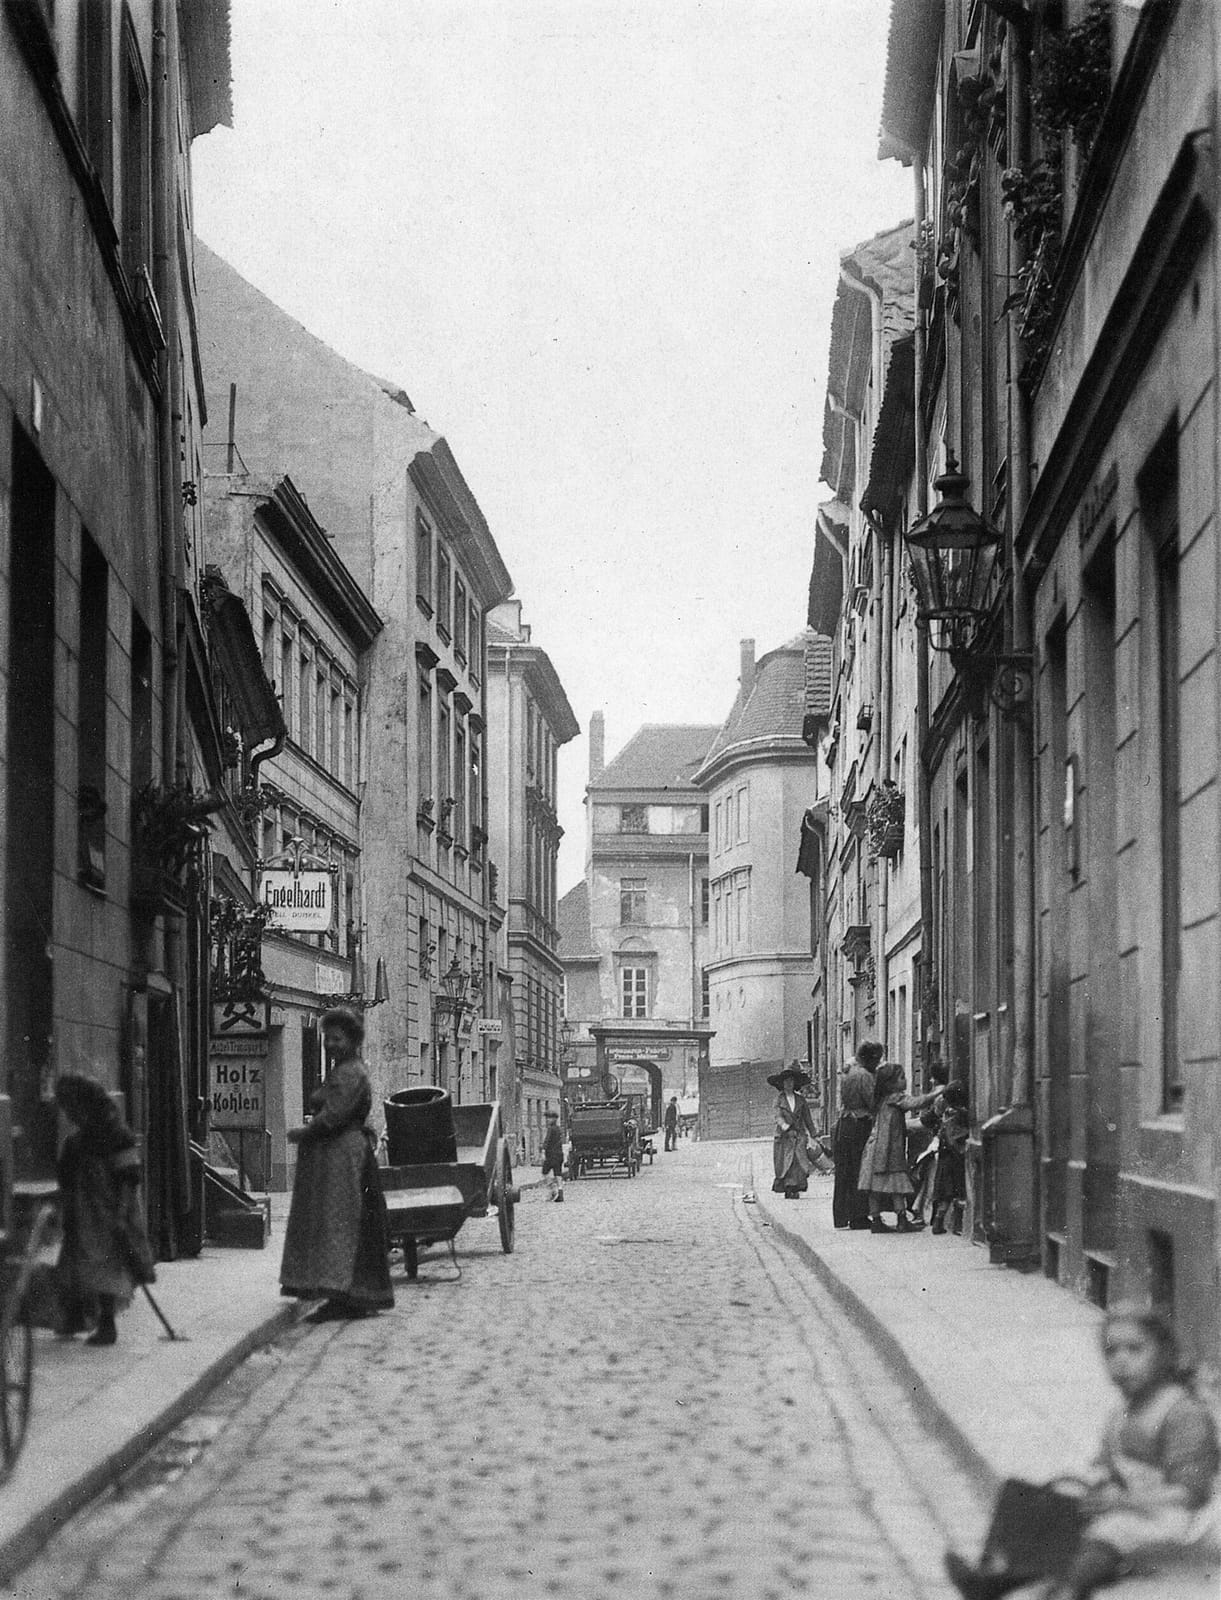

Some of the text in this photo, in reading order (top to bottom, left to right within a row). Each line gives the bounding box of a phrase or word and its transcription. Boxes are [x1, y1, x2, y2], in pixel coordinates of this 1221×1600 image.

[265, 880, 326, 908] Engelhardt
[216, 1065, 261, 1083] Holz
[213, 1092, 259, 1113] Kohlen
